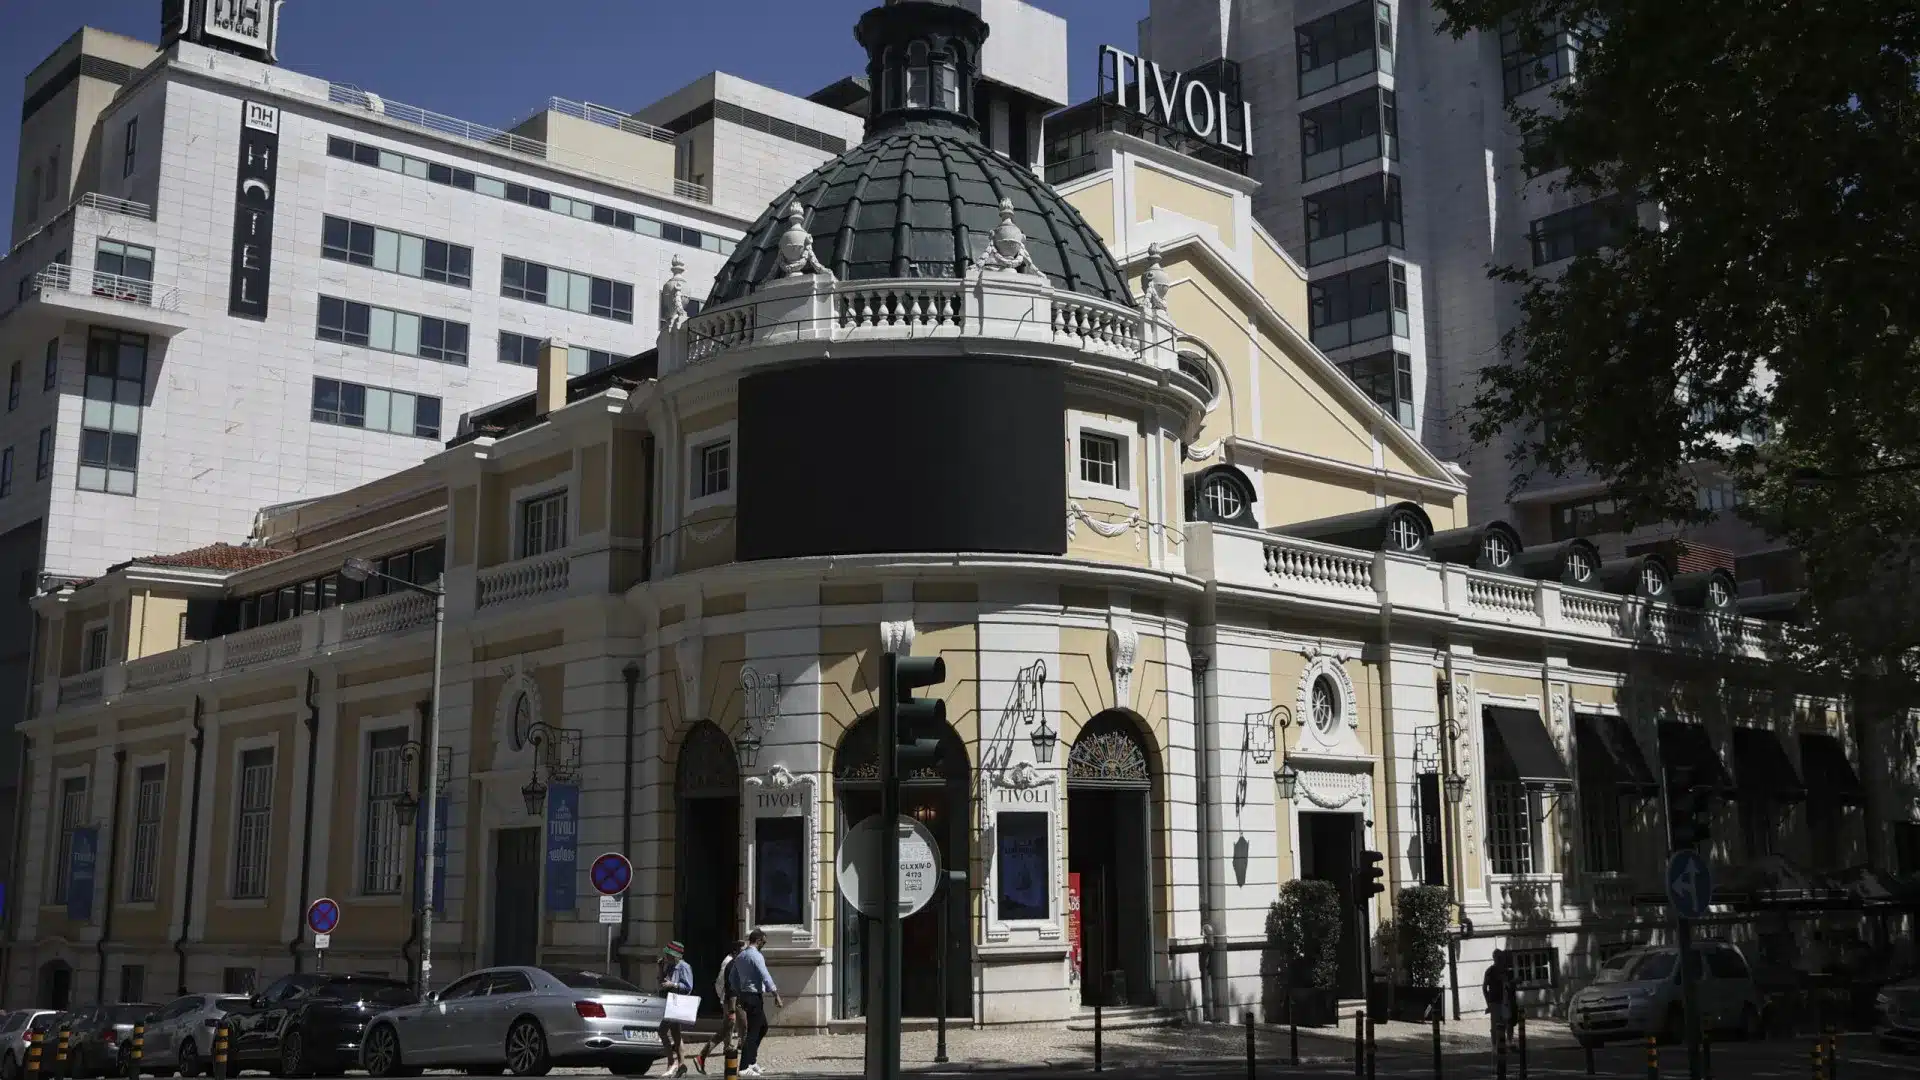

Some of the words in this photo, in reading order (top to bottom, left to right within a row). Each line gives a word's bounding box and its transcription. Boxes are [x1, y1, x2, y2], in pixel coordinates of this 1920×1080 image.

[1104, 44, 1254, 156] TIVOLI
[241, 143, 271, 304] HOTEL
[757, 792, 804, 809] TIVOLI
[998, 789, 1049, 804] TIVOLI
[550, 820, 575, 835] TIVOLI
